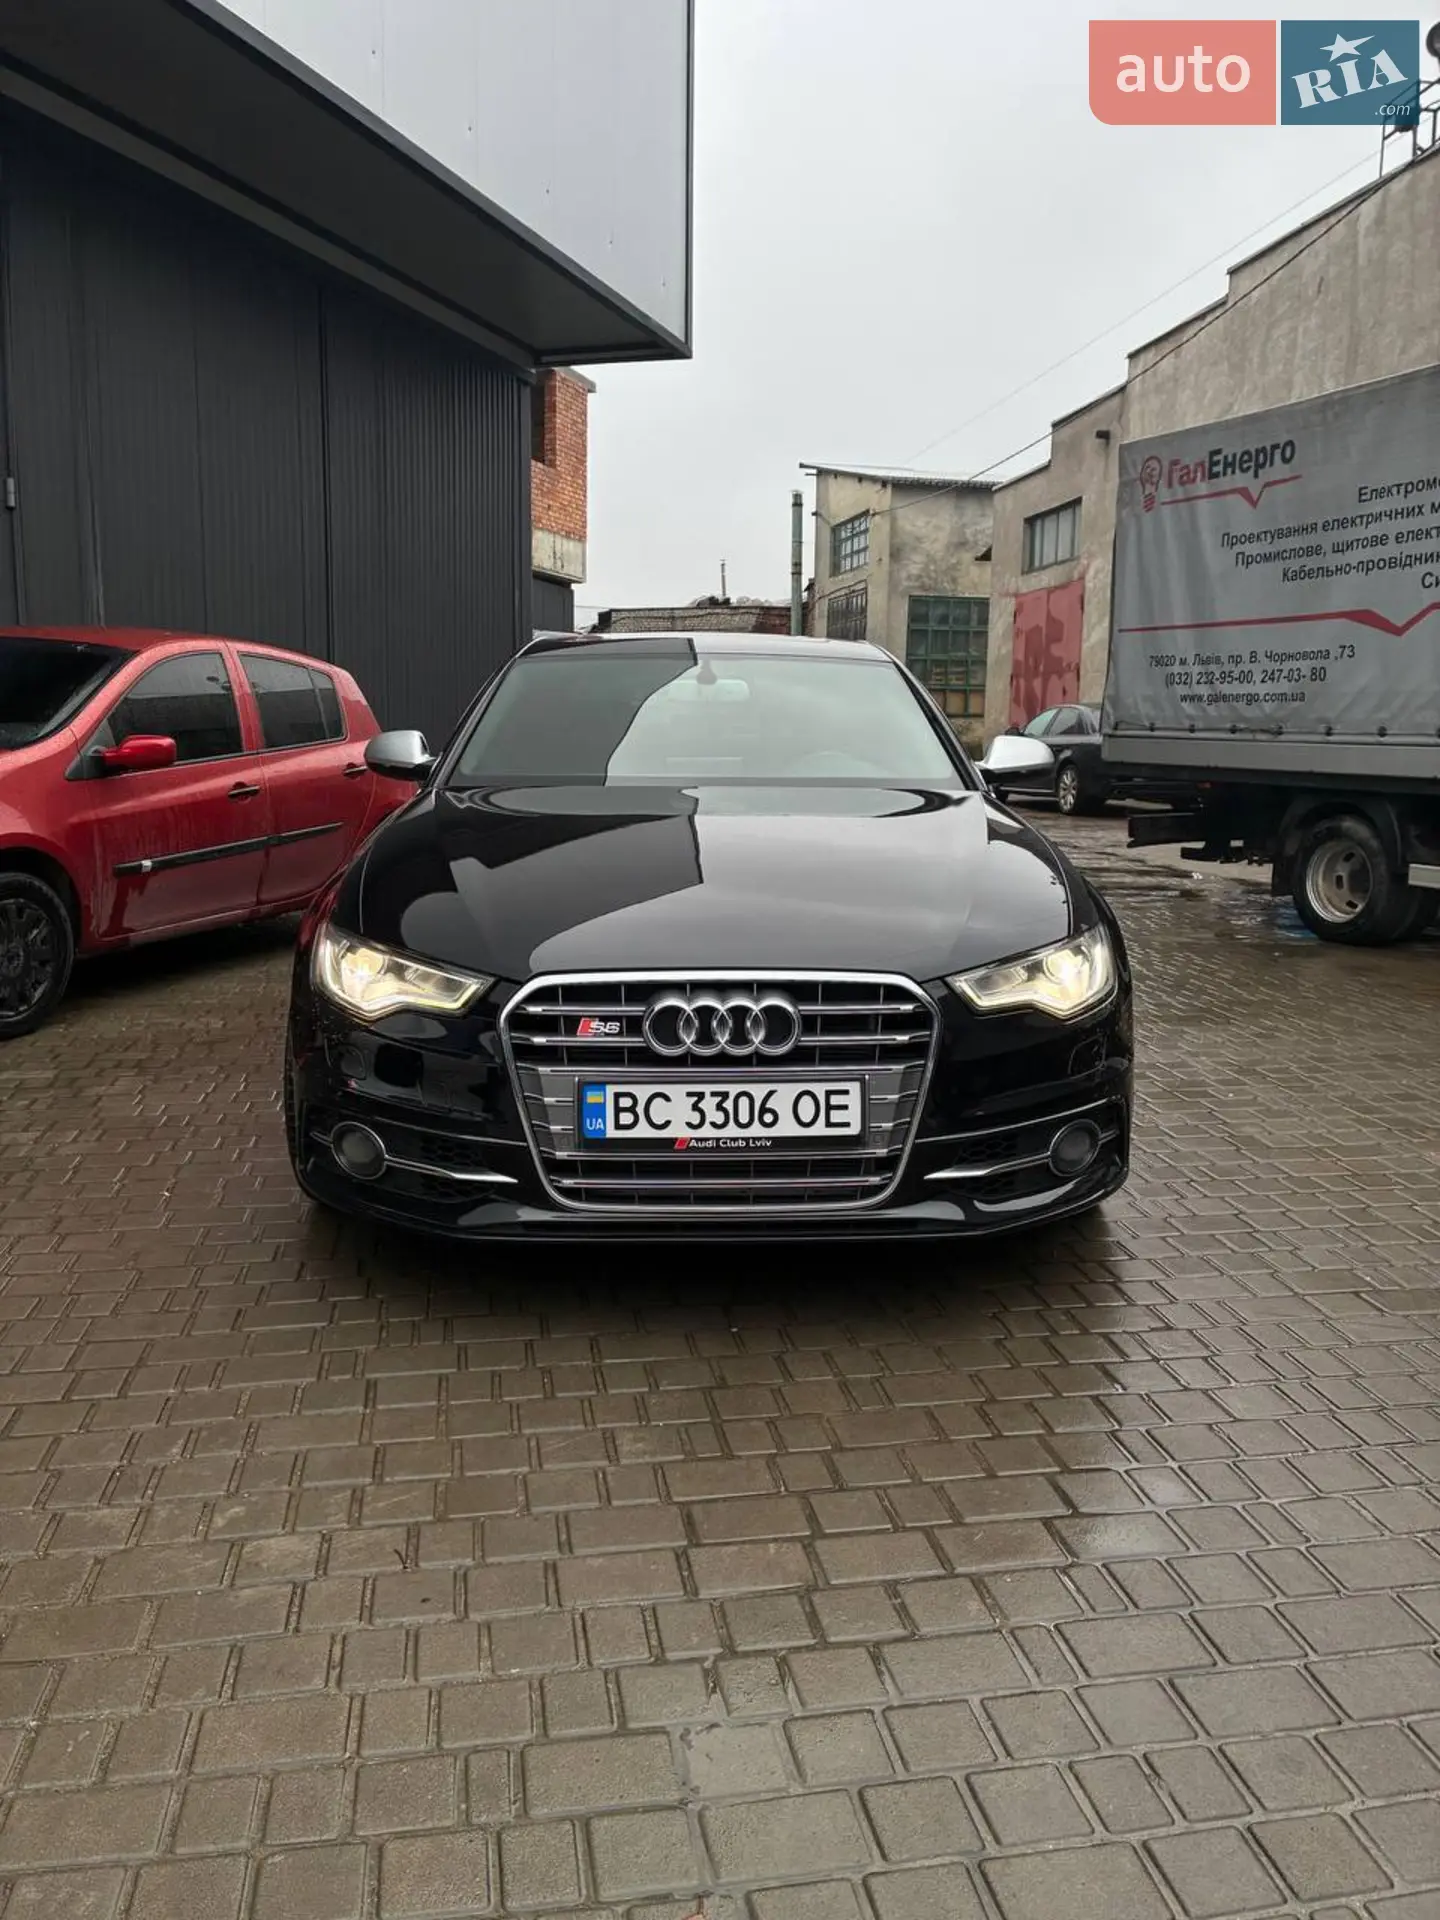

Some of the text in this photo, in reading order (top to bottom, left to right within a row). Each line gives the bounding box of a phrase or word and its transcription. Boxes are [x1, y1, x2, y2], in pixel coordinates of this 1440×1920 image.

[1165, 440, 1296, 489] ГалЕнерго
[1358, 476, 1440, 503] Електром
[1221, 521, 1318, 549] Проектування
[1322, 503, 1425, 532] електричних
[1235, 543, 1327, 569] Промислове,
[1332, 532, 1389, 555] щитове
[1227, 654, 1246, 668] пр.
[1264, 649, 1331, 666] Чорновола
[1165, 671, 1193, 688] (032)
[1310, 666, 1327, 682] 80
[1179, 690, 1305, 706] www.galenergo.com.ua
[590, 1021, 620, 1034] S6
[613, 1088, 851, 1130] BC 3306 OE
[586, 1118, 604, 1131] UA
[689, 1138, 772, 1148] Audi Club Lviv
